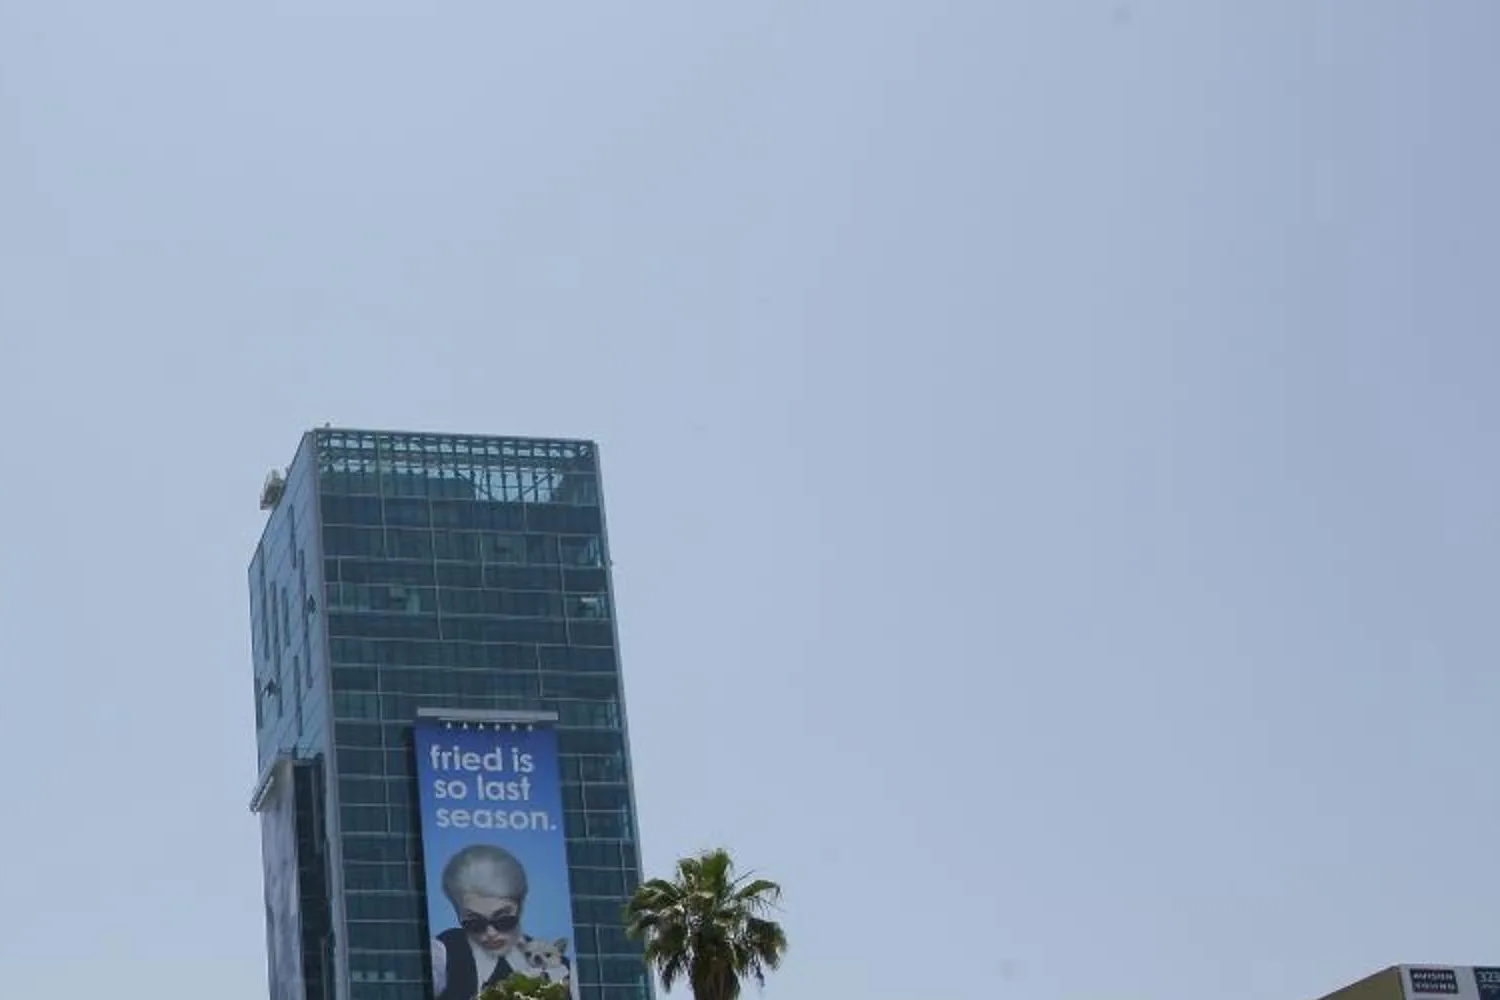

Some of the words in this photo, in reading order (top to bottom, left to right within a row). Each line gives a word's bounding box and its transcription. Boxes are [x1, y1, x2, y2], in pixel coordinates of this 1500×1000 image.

[430, 744, 504, 773] fried
[510, 747, 535, 773] is
[433, 777, 468, 801] so
[476, 774, 532, 801] last
[435, 804, 558, 832] season.
